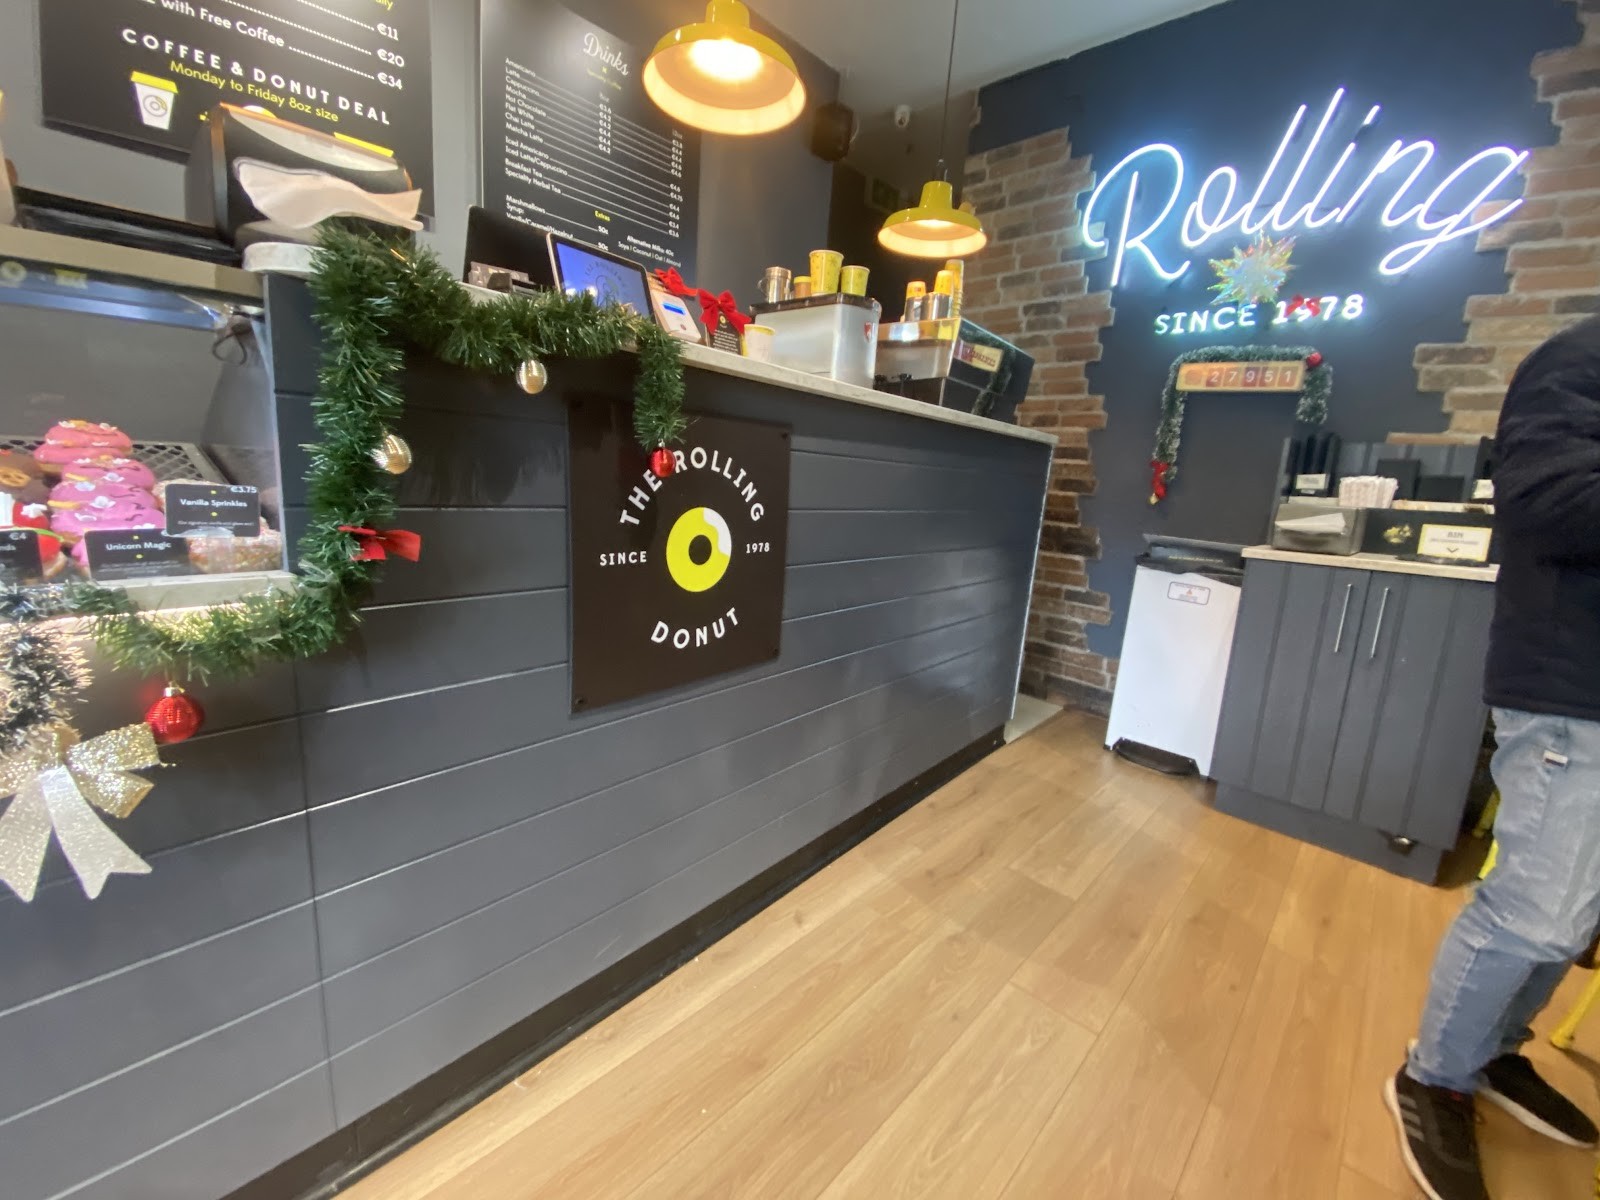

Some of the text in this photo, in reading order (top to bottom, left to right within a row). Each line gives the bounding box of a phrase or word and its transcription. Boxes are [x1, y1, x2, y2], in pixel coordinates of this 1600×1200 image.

[377, 23, 399, 40] €11
[161, 0, 403, 90] with Free Coffee €34
[583, 32, 629, 76] Drinks
[377, 48, 405, 67] €20
[505, 57, 536, 78] Americano
[122, 29, 390, 125] COFFEE & DONUT DEAL
[505, 66, 521, 79] Latte
[170, 60, 339, 122] Monday to Friday 8oz size
[505, 75, 540, 96] Cappuccino
[505, 84, 527, 100] Mocha
[505, 93, 516, 103] Hot
[517, 99, 547, 118] Chocolate
[505, 102, 517, 113] Flat
[517, 107, 535, 120] White
[504, 111, 519, 123] Chai
[520, 118, 535, 130] Latte
[505, 121, 528, 137] Matcha
[529, 132, 544, 144] Latte
[505, 135, 519, 147] Iced
[519, 142, 549, 160] Americano
[505, 145, 519, 157] Iced
[519, 151, 568, 176] Latte/Cappuccino
[505, 157, 532, 174] Breakfast
[532, 168, 543, 178] Tea
[505, 167, 532, 185] Specialty
[532, 177, 551, 190] Herbal
[551, 184, 562, 194] Tea
[1082, 87, 1529, 287] Rolling
[505, 194, 546, 214] Marshmallows
[594, 210, 611, 222] Extras
[626, 234, 652, 249] Alternative
[618, 240, 682, 268] Soya Coconut Oat Almond
[1154, 303, 1258, 335] SINCE
[230, 485, 257, 494] €3.75
[619, 446, 765, 525] THE ROLLING
[179, 498, 248, 508] Vanilla Sprinkles
[9, 532, 27, 541] €4
[105, 541, 172, 551] Unicorn Magic
[599, 542, 770, 566] SINCE 1978
[650, 607, 739, 649] DONUT
